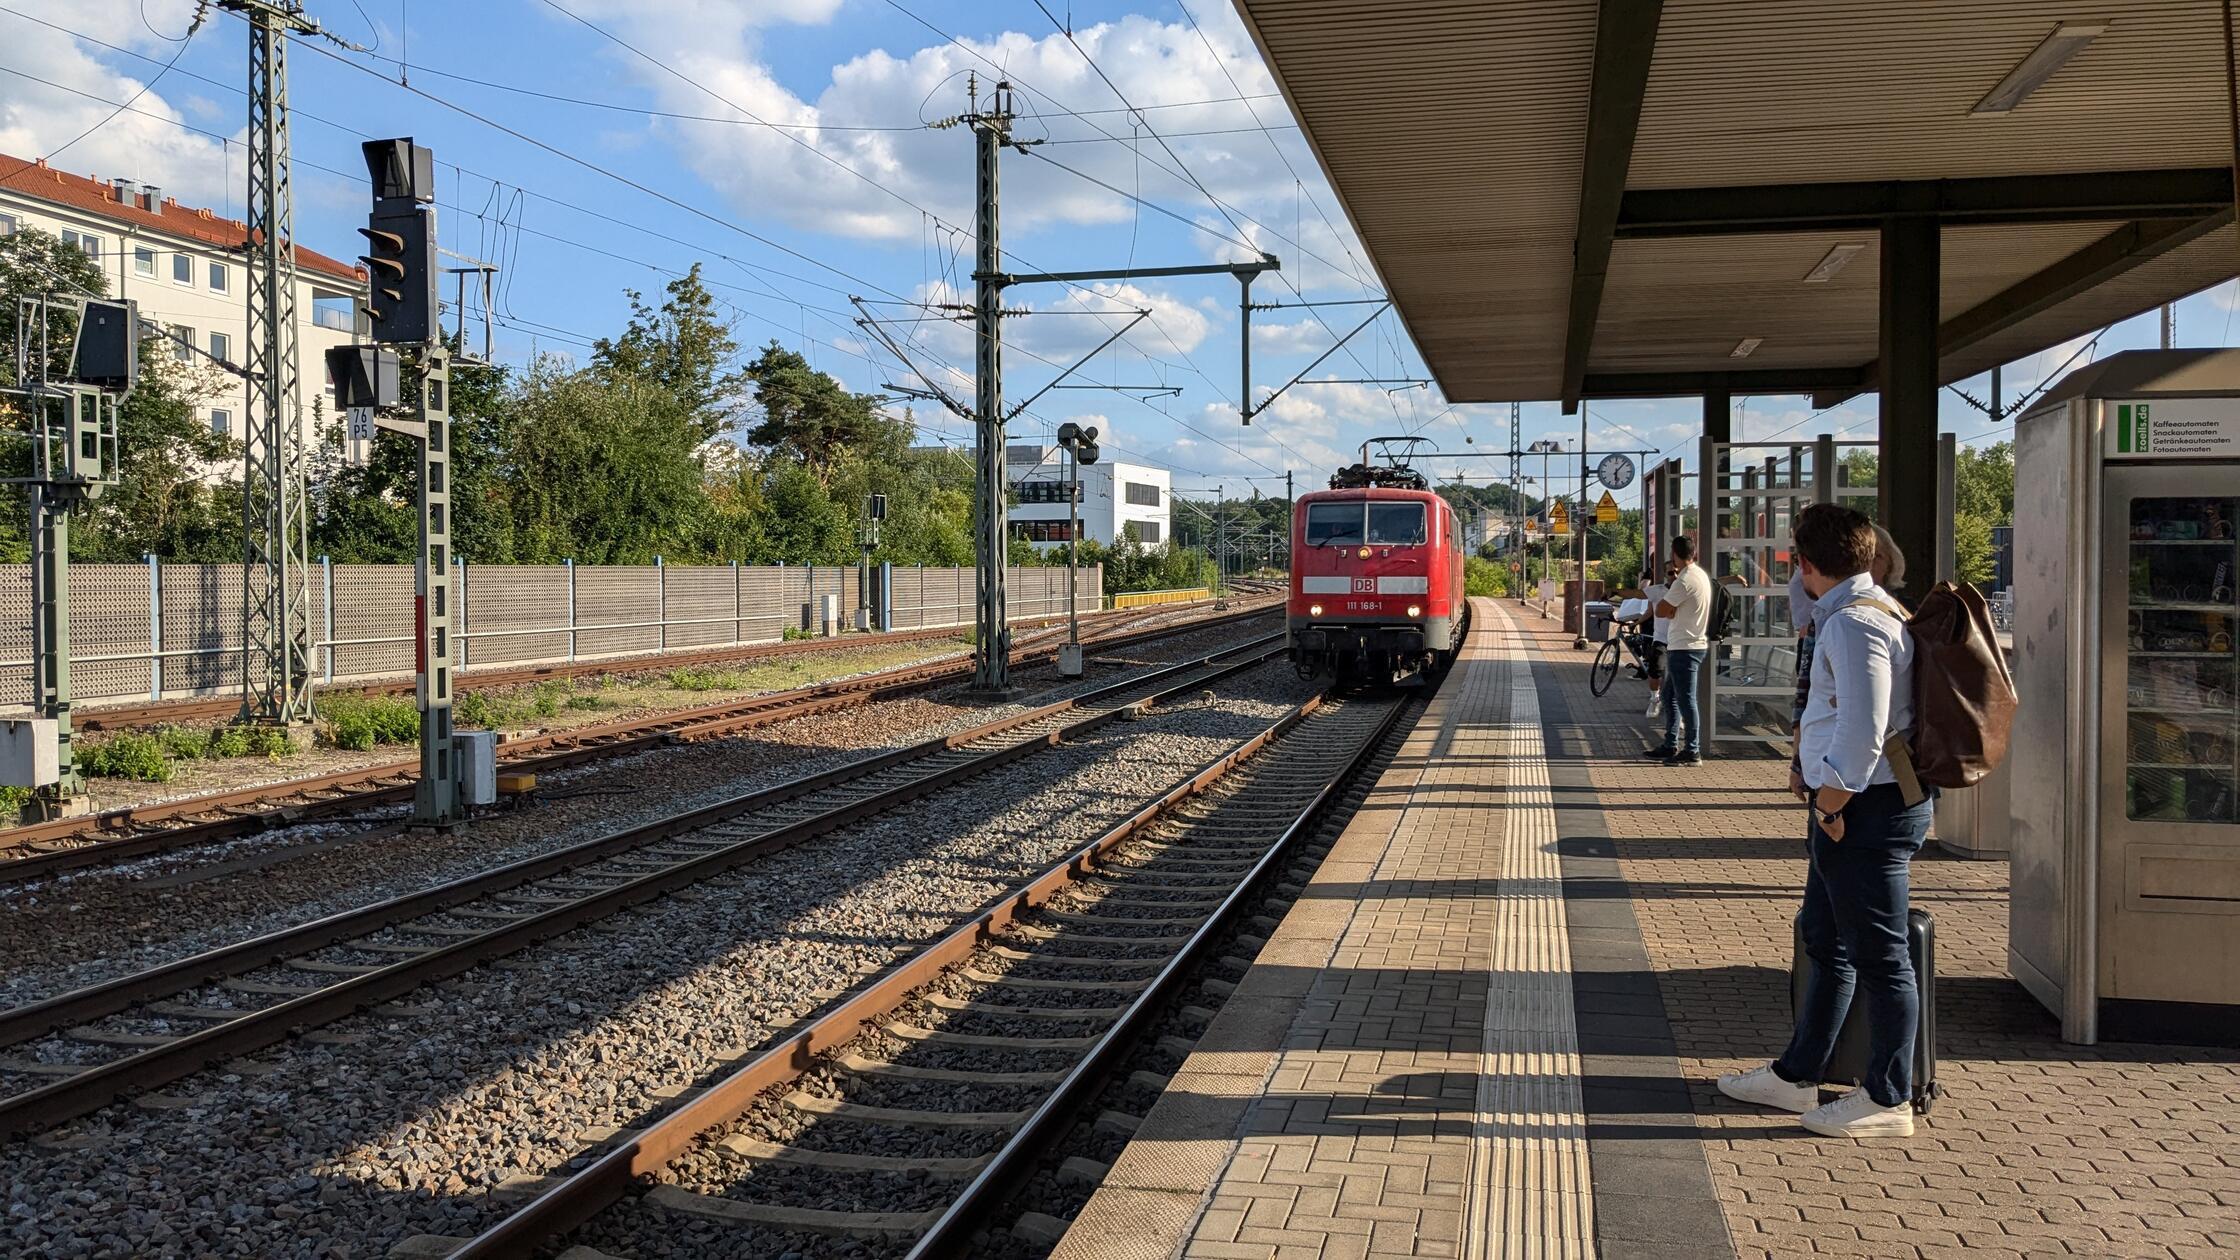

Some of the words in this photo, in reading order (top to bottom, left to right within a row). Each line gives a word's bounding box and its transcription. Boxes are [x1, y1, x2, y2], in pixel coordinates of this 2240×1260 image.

[353, 407, 367, 423] 76
[2153, 420, 2219, 428] Kaffeeautomaten
[353, 424, 367, 439] P5
[2153, 437, 2231, 445] Getränkeautomaten
[1355, 579, 1373, 591] DB
[1347, 601, 1357, 610] 111
[1360, 601, 1382, 610] 168-1
